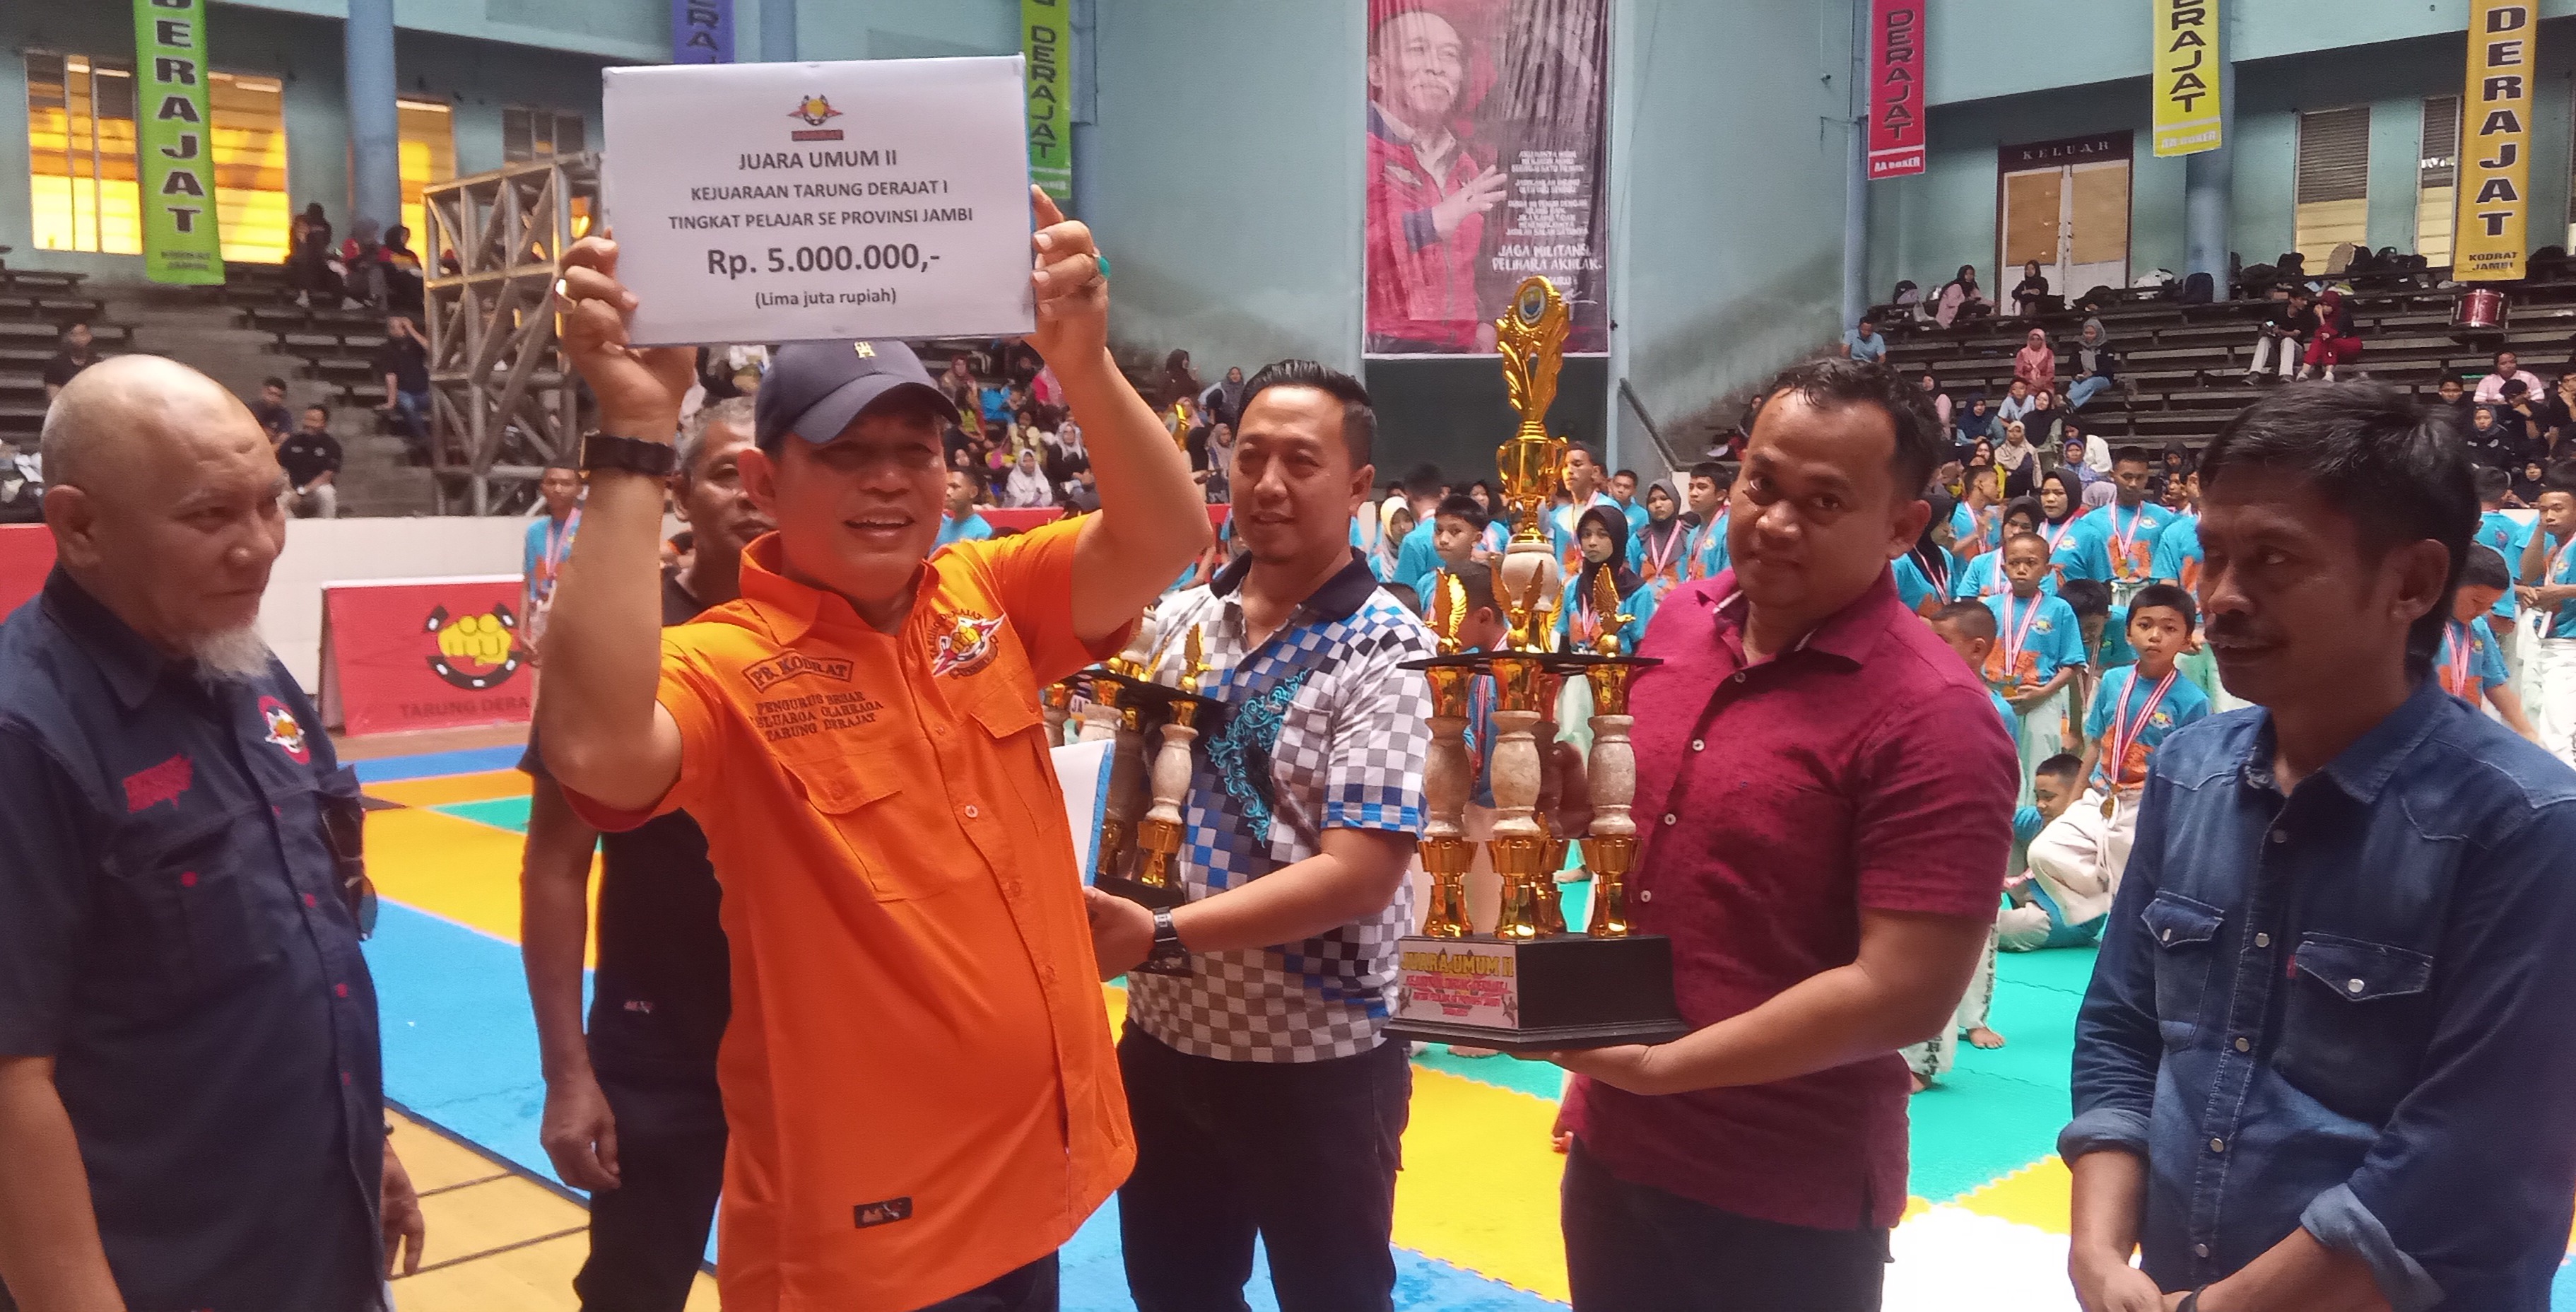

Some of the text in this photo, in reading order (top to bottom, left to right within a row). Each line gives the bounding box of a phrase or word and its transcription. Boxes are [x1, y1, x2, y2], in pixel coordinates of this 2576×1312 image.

[1884, 8, 1915, 139] DERAJAT
[1031, 25, 1057, 159] DERAJAT
[2476, 6, 2527, 236] DERAJAT
[739, 150, 897, 170] JUARA UMUM II
[2023, 141, 2108, 160] KELUAR
[691, 180, 948, 201] KEJUARAAN TARUNG DERAJAT I
[669, 207, 973, 230] TINGKAT PELAJAR SE PROVINSI JAMBI
[707, 243, 940, 280] Rp. 5.000.000,-
[1498, 245, 1531, 257] JAGA
[2469, 252, 2517, 262] KODRAT
[1492, 257, 1546, 271] PELIHARA
[755, 288, 897, 308] (Lima juta rupiah)
[776, 655, 848, 678] KODRAT
[755, 693, 823, 715] PENGURUS
[824, 713, 876, 730] DERAJAT
[1401, 952, 1448, 973] JUARA
[1450, 954, 1500, 976] UMUM
